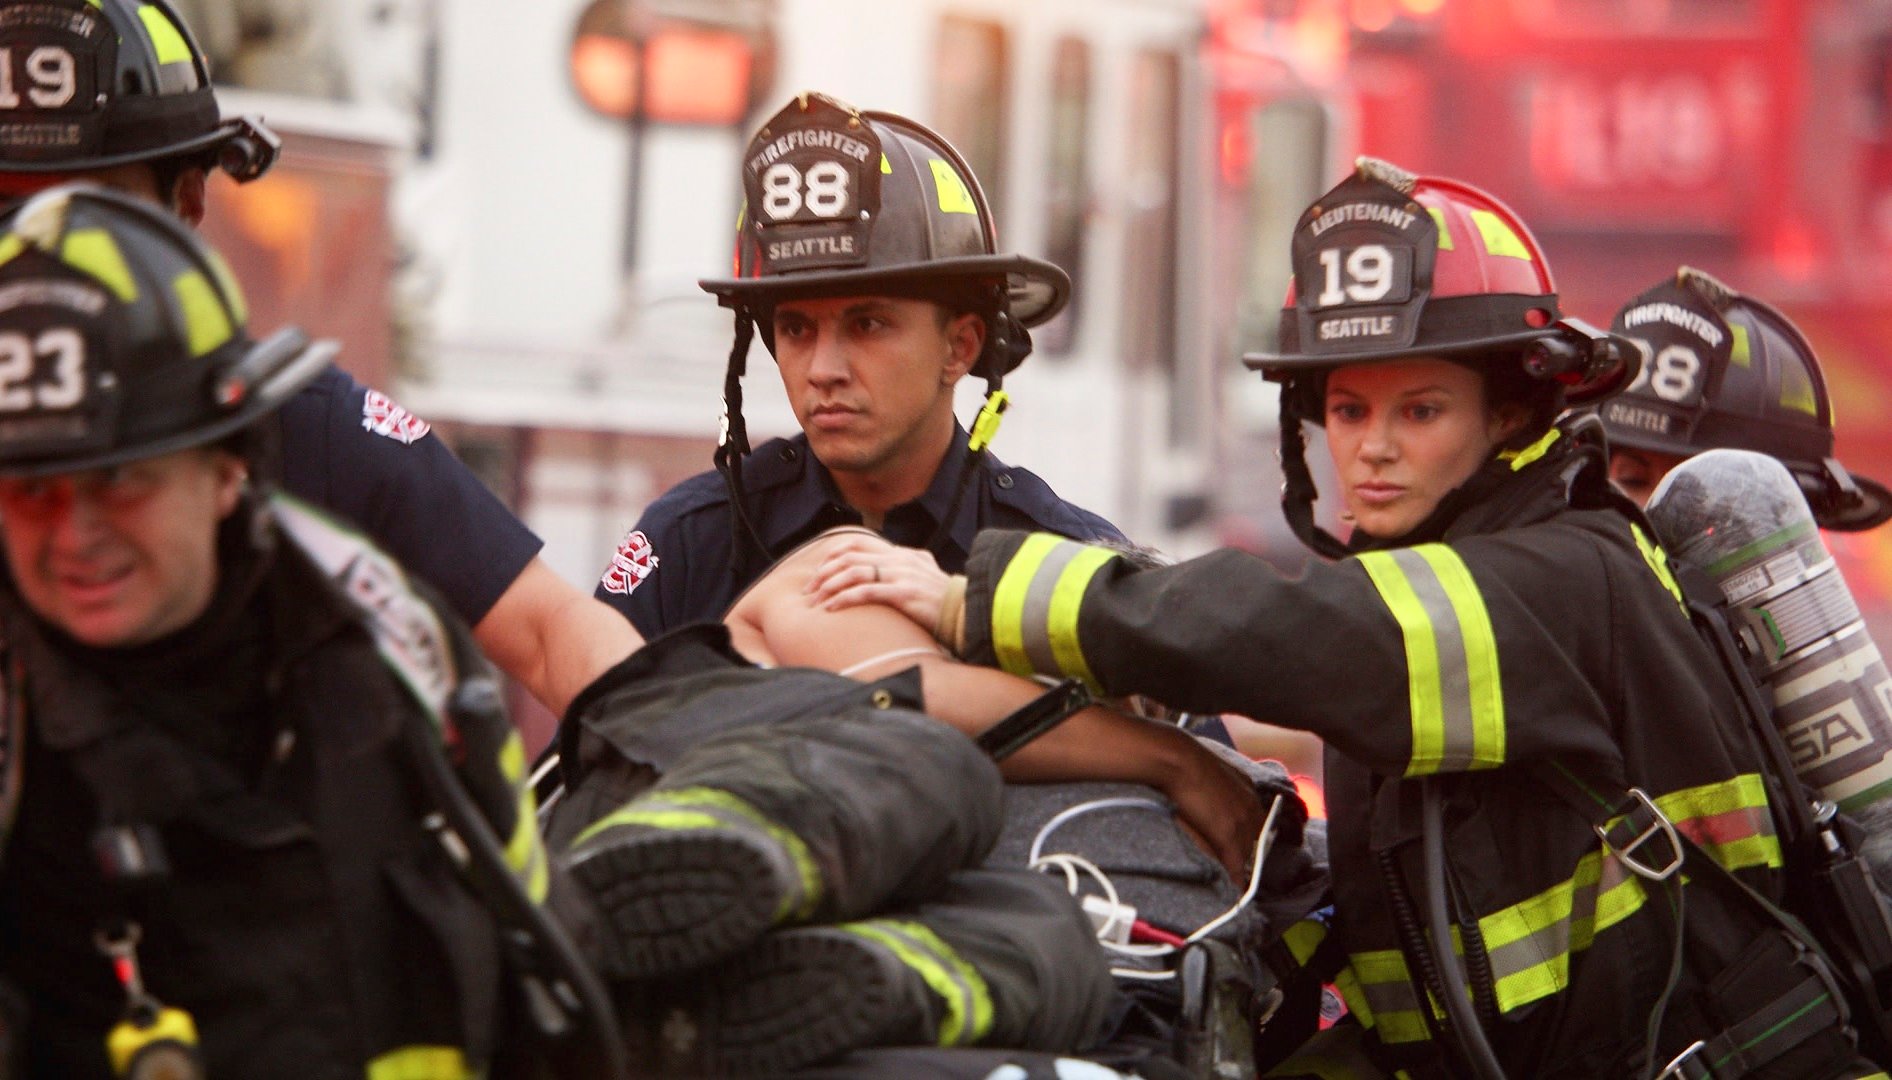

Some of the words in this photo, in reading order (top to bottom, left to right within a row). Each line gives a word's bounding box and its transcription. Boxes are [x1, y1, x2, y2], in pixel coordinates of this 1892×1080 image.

[0, 46, 76, 109] 19
[750, 129, 870, 177] FIREFIGHTER
[762, 161, 850, 220] 88
[1311, 203, 1416, 237] LIEUTENANT
[769, 237, 853, 260] SEATTLE
[1319, 245, 1394, 306] 19
[1320, 315, 1394, 339] SEATTLE
[1624, 302, 1723, 348] FIREFIGHTER
[0, 329, 84, 411] 23
[1785, 713, 1864, 768] SA
